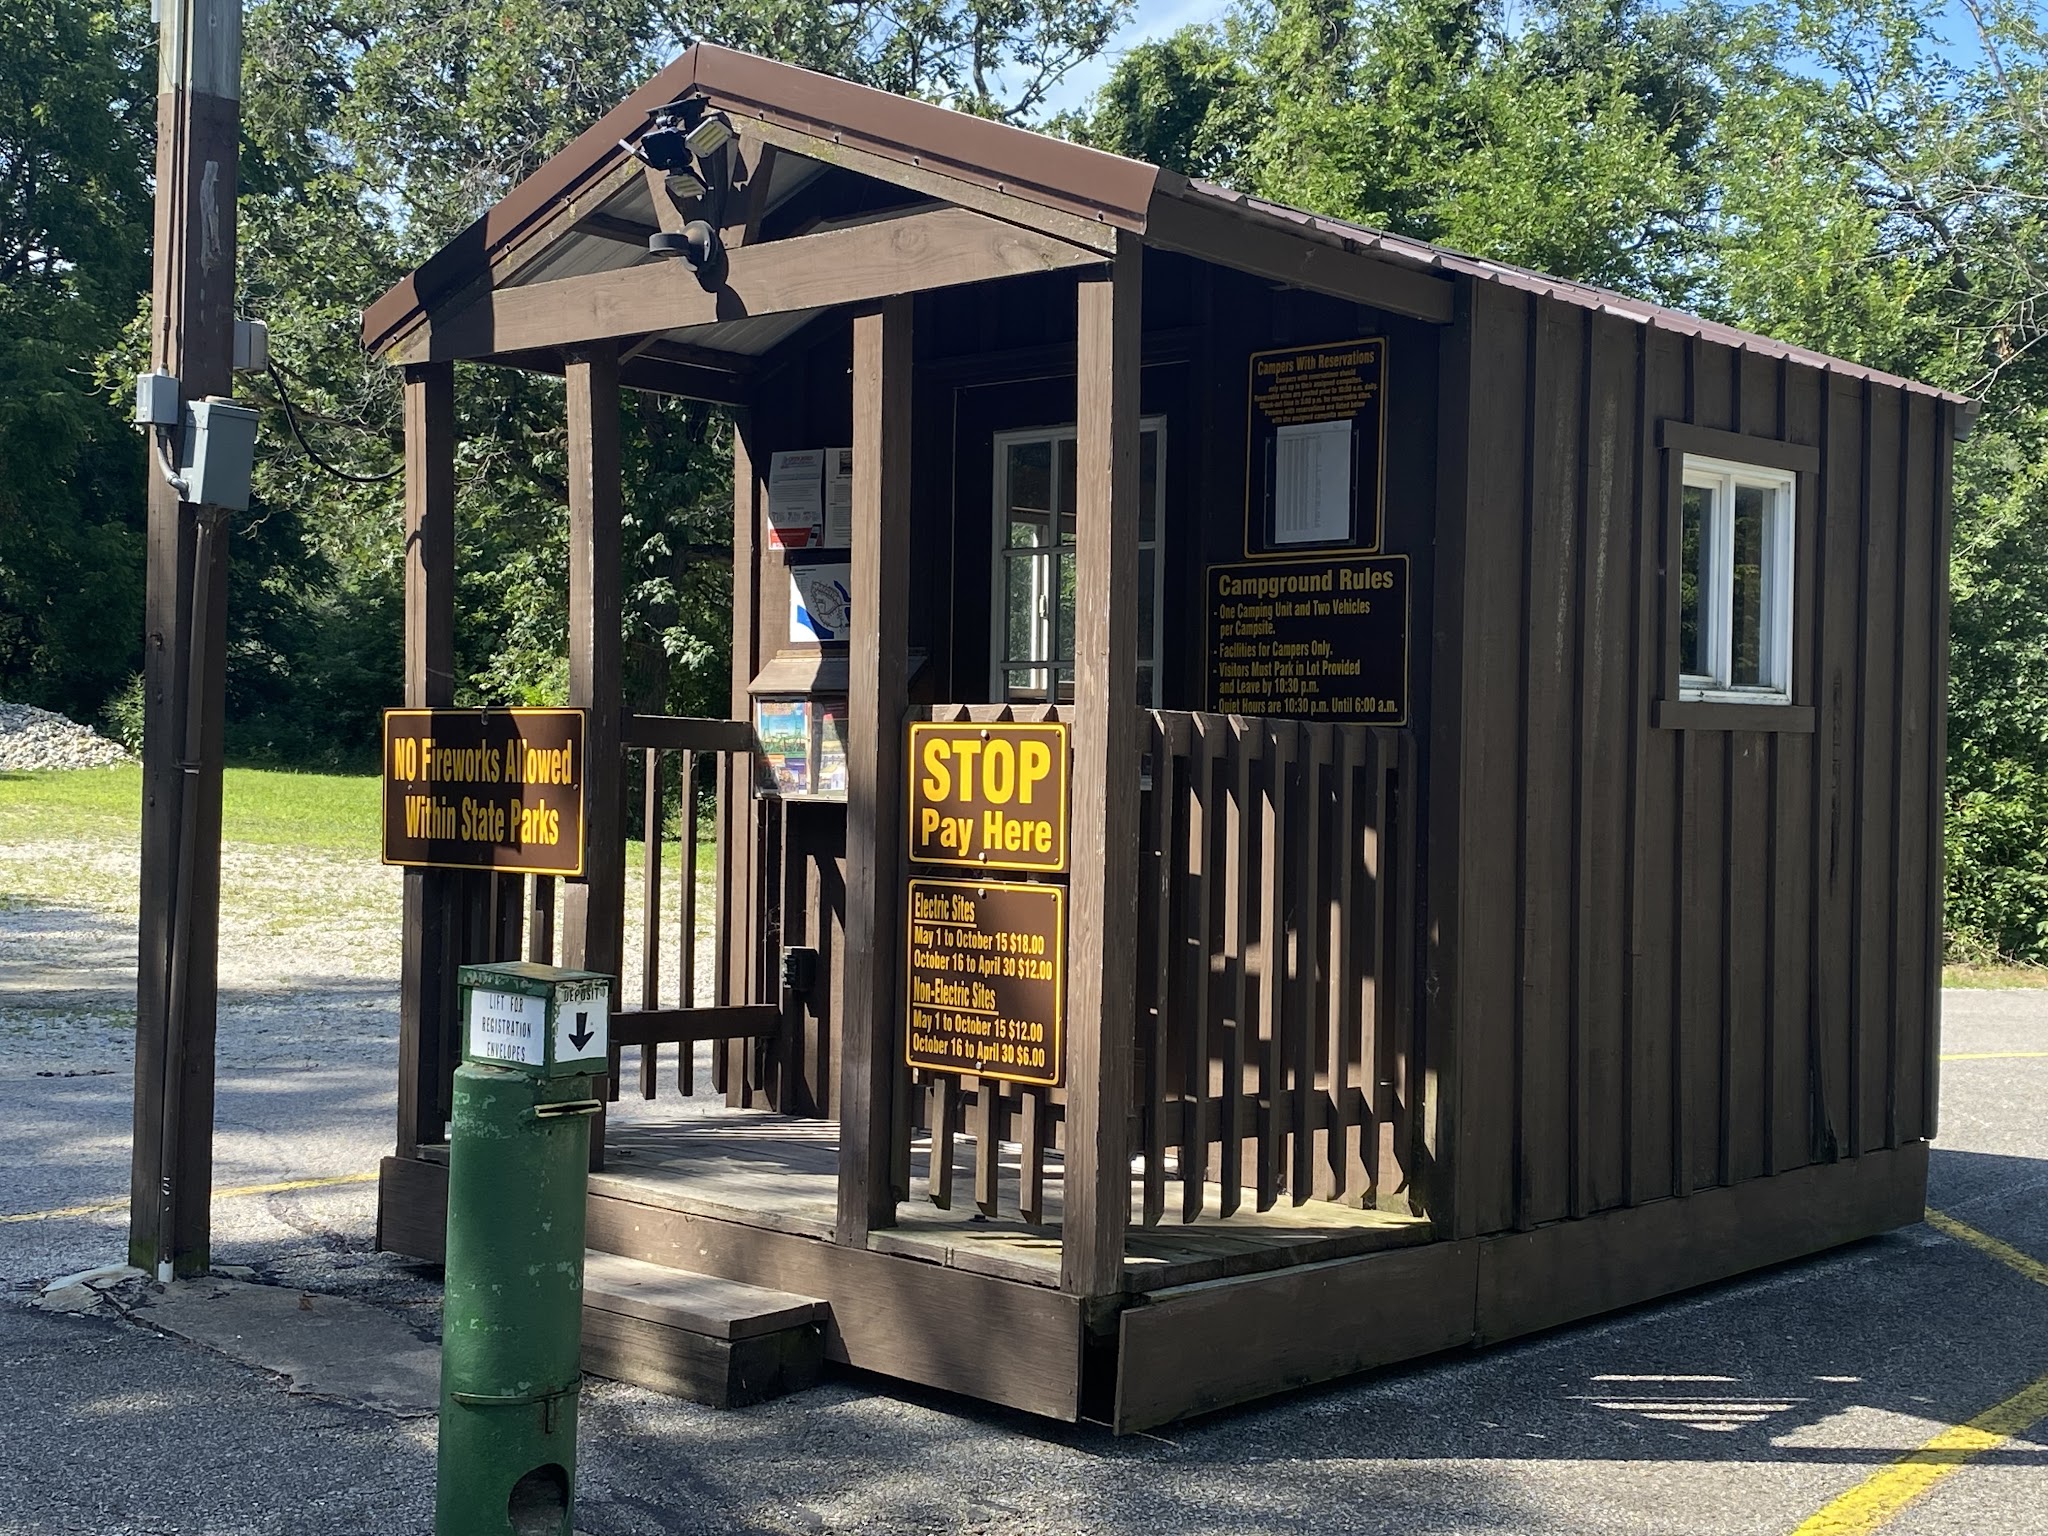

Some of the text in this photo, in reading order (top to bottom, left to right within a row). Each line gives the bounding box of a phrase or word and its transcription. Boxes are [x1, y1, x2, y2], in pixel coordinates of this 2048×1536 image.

[1258, 350, 1374, 377] Campers With Reservations
[1219, 567, 1393, 599] Campground Rules
[1220, 599, 1370, 620] One Camping Unit and Two Vehicles
[1220, 621, 1275, 639] per Campsite.
[1220, 640, 1333, 659] Facilities for Campers Only.
[1219, 659, 1360, 677] Visitors Must Park in Lot Provided
[1220, 678, 1319, 696] and Leave by 10:30 p.m.
[1219, 698, 1397, 716] Quiet Hours are 10:30 p.m. Until 6:00 a.m.
[394, 737, 572, 784] NO Fireworks Allowed
[923, 738, 1050, 804] STOP
[405, 795, 558, 845] Within State Parks
[922, 808, 1051, 856] Pay Here
[915, 892, 974, 922] Electric Sites
[914, 926, 1044, 955] May 1 to October 15 $18.00
[914, 949, 1052, 980] October 16 to April 30 $12.00
[489, 994, 523, 1012] LIFT FOR
[564, 987, 598, 1002] DEPOSIT
[914, 976, 995, 1010] Non-Electric Sites
[482, 1017, 531, 1038] REGISTRATION
[913, 1009, 1043, 1043] May 1 to October 15 $12.00
[487, 1042, 525, 1062] ENVELOPES
[913, 1033, 1045, 1067] October 16 to April 30 $6.00
